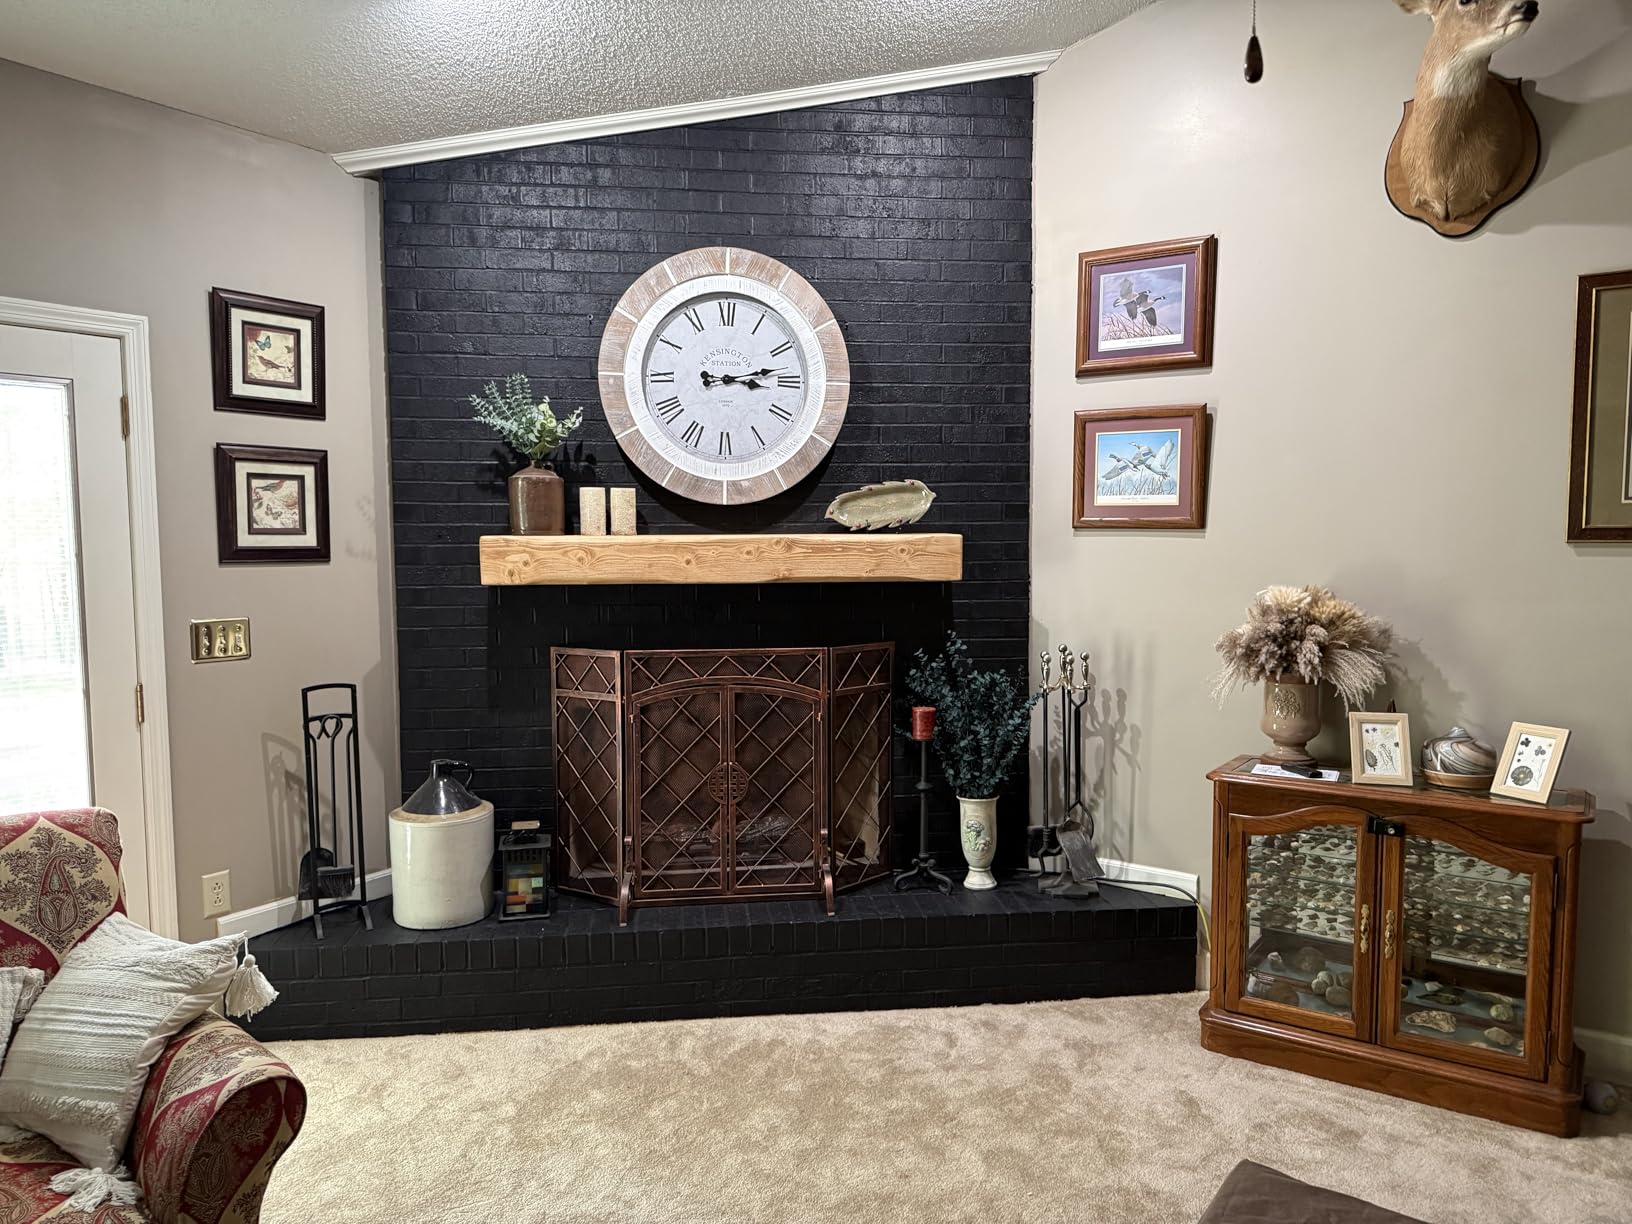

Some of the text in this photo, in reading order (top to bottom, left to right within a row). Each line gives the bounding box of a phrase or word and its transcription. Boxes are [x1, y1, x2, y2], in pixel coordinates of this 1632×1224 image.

[683, 307, 705, 335] XI
[717, 301, 737, 327] XII
[751, 313, 766, 335] I
[659, 334, 683, 355] X
[769, 339, 793, 358] II
[700, 348, 753, 369] KENSINGTON
[650, 369, 675, 384] IX
[777, 375, 801, 390] III
[655, 395, 685, 426] VIII
[768, 403, 793, 426] IV
[680, 420, 705, 449] VII
[718, 431, 732, 456] VI
[751, 425, 766, 449] V
